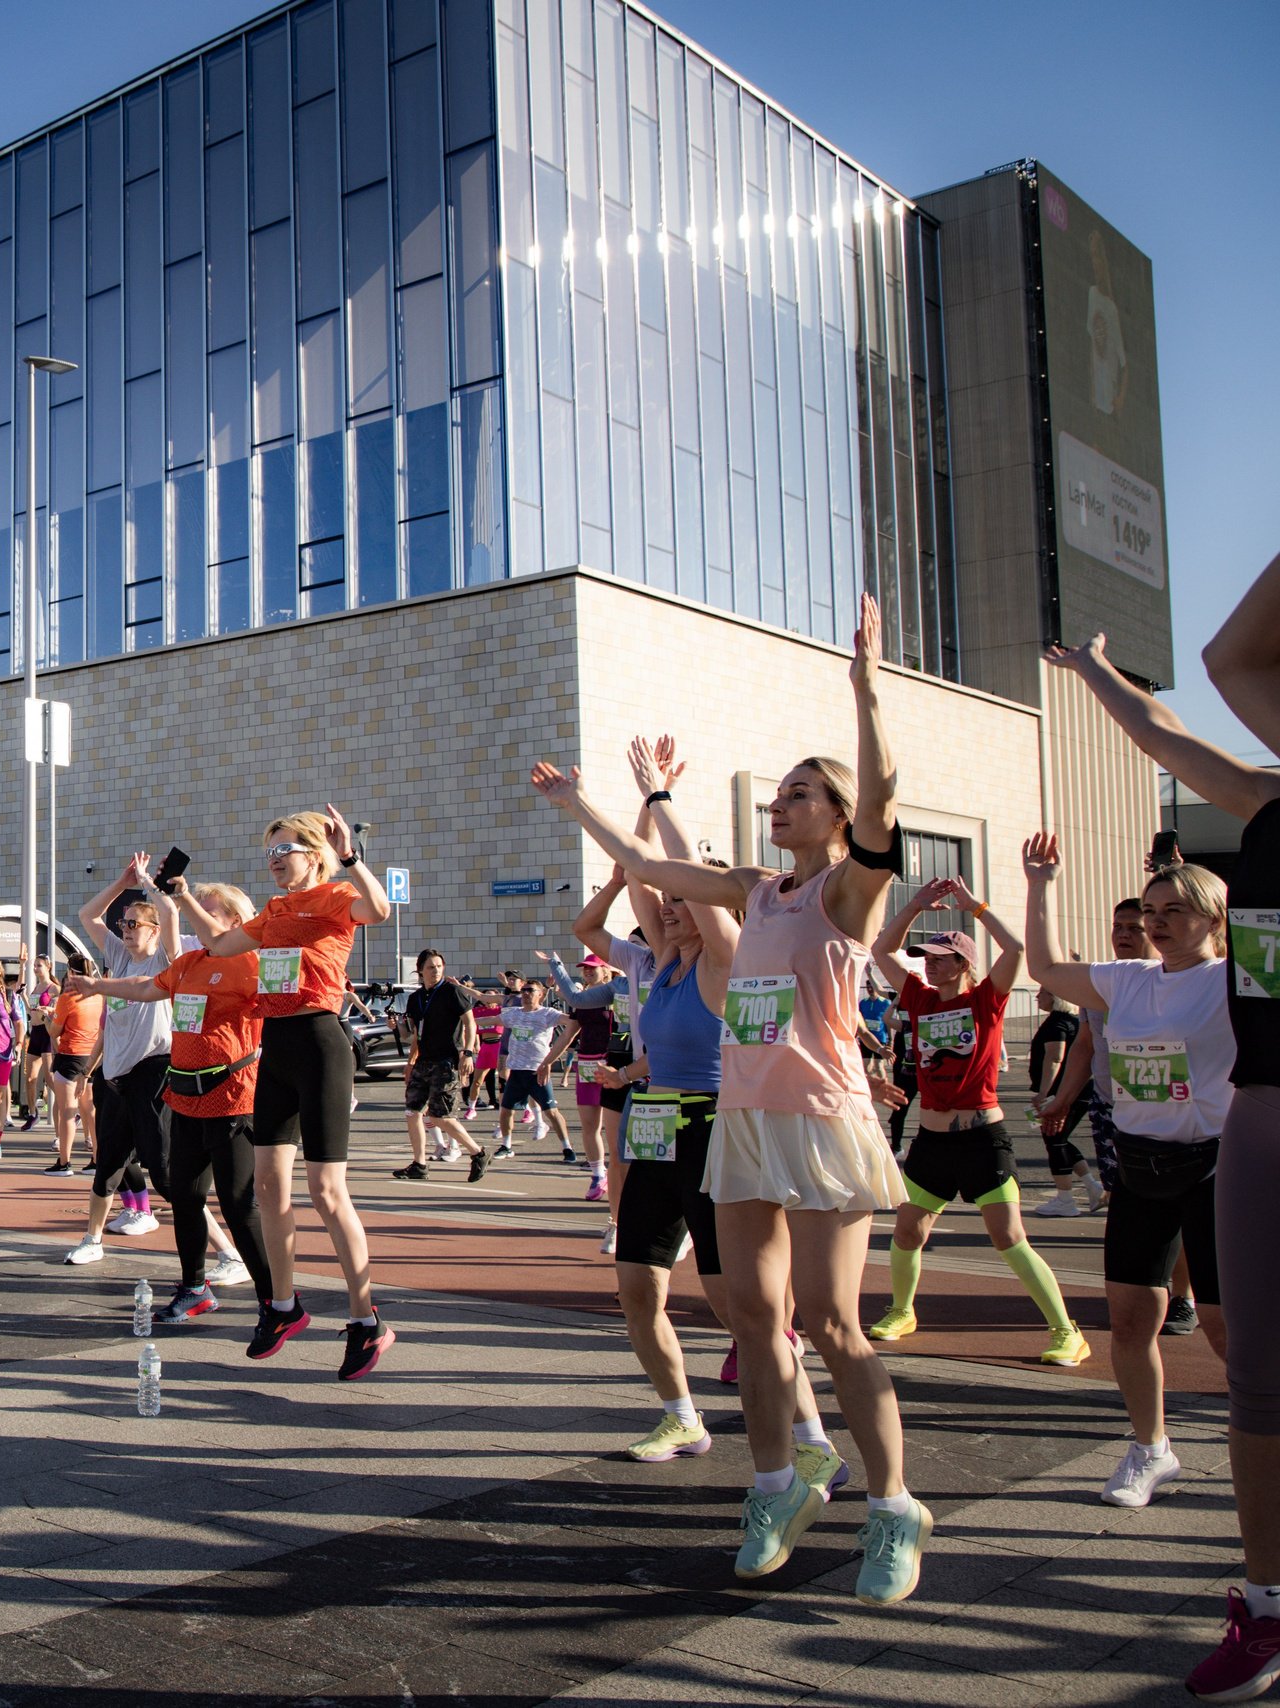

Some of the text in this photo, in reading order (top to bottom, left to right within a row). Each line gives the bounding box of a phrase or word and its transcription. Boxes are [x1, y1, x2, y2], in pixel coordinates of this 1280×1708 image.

[1068, 479, 1105, 518] LanMar
[392, 870, 406, 900] P
[531, 883, 540, 891] 13
[1259, 935, 1280, 973] 7
[264, 961, 291, 981] 5254
[282, 982, 290, 993] E
[177, 1004, 198, 1022] 5252
[737, 995, 778, 1026] 7100
[189, 1022, 196, 1032] E
[751, 1030, 760, 1041] KM
[763, 1024, 775, 1042] E
[930, 1019, 963, 1039] 5313
[1124, 1059, 1171, 1086] 7237
[1143, 1083, 1186, 1099] 5 KM E
[631, 1120, 665, 1145] 6353
[656, 1143, 667, 1157] D
